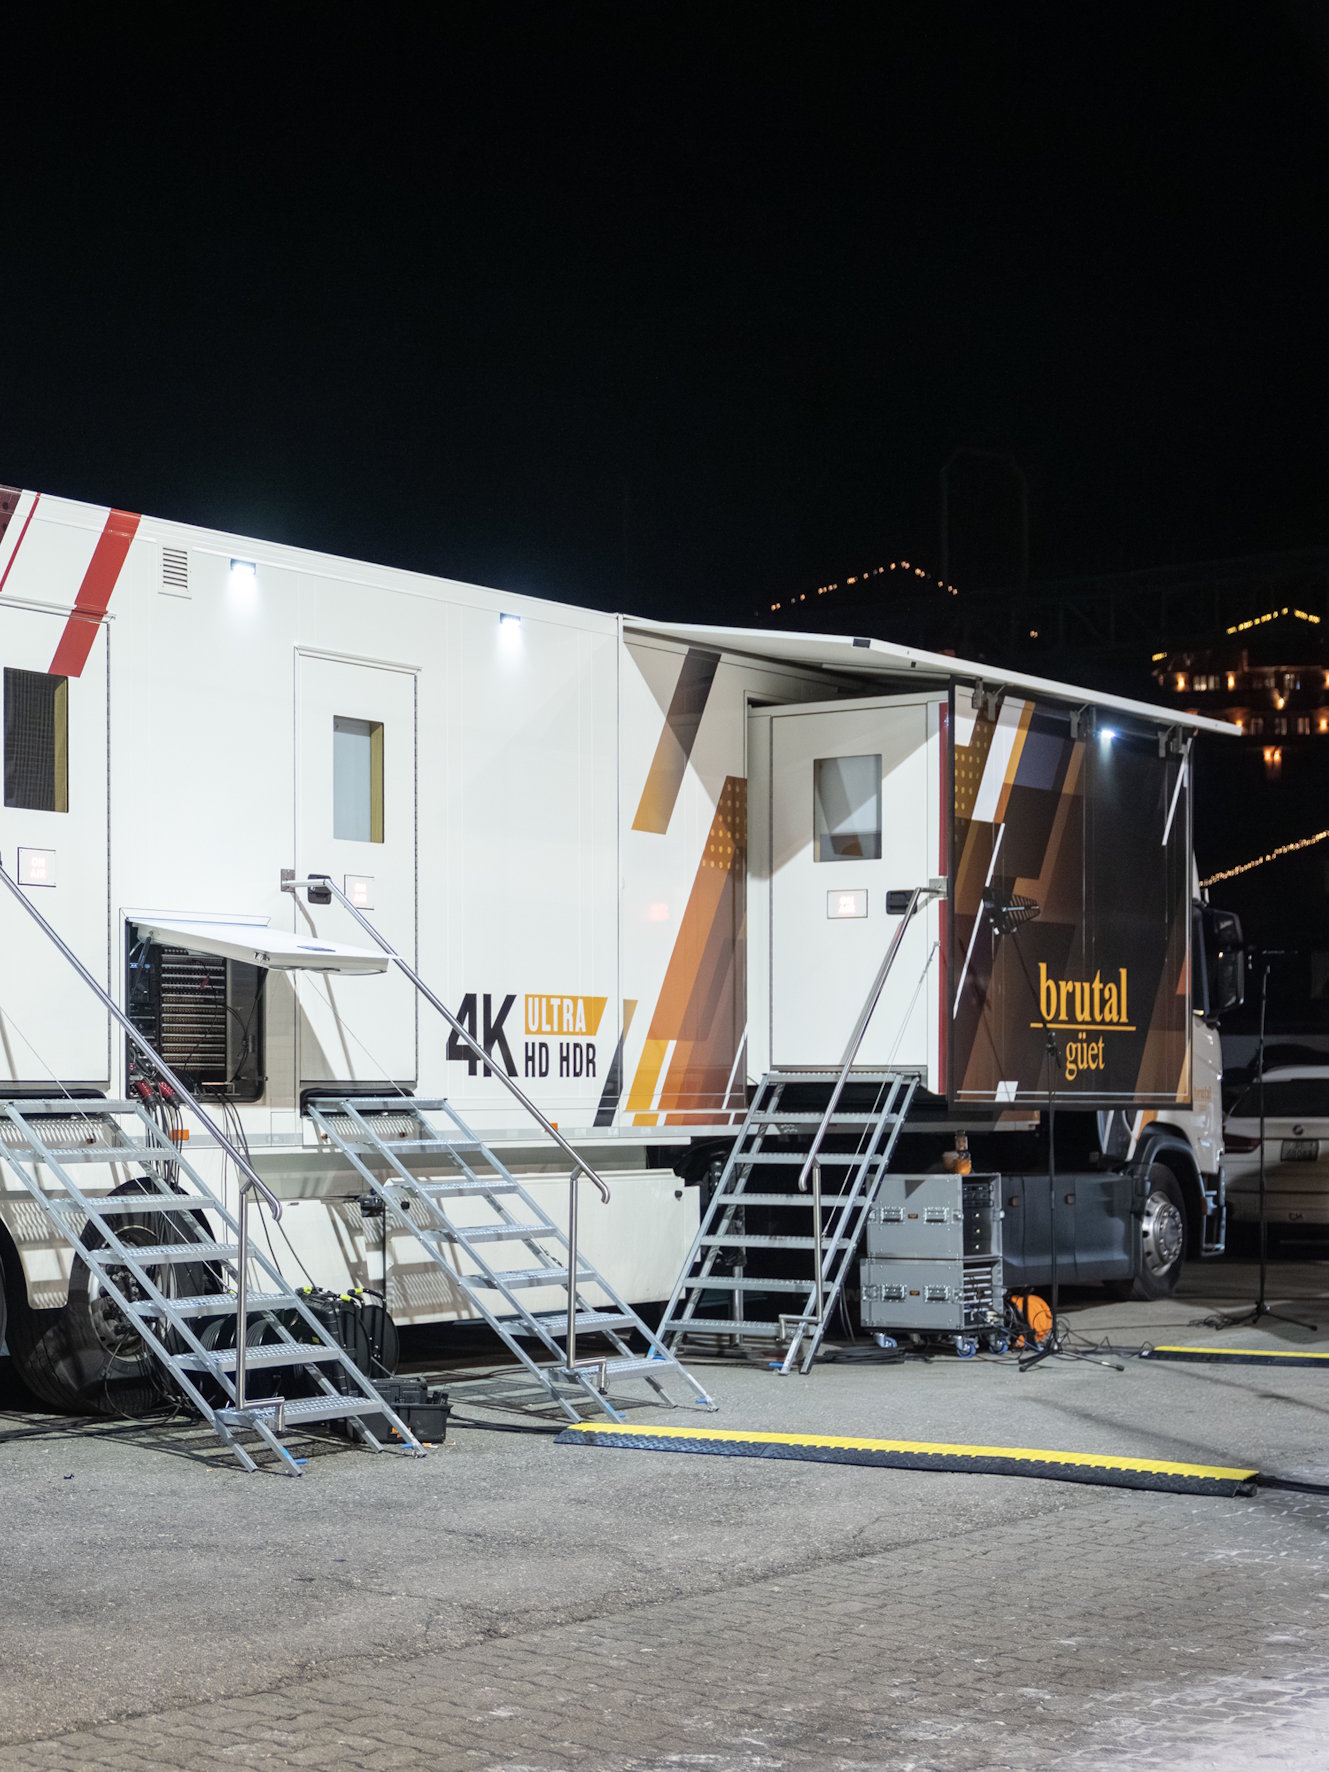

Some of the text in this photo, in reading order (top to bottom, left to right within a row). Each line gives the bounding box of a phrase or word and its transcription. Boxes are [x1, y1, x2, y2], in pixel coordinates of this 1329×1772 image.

[1038, 962, 1129, 1023] brutal
[446, 993, 587, 1078] 4K ULTRA
[525, 1042, 596, 1078] HD HDR
[1065, 1032, 1105, 1081] güet
